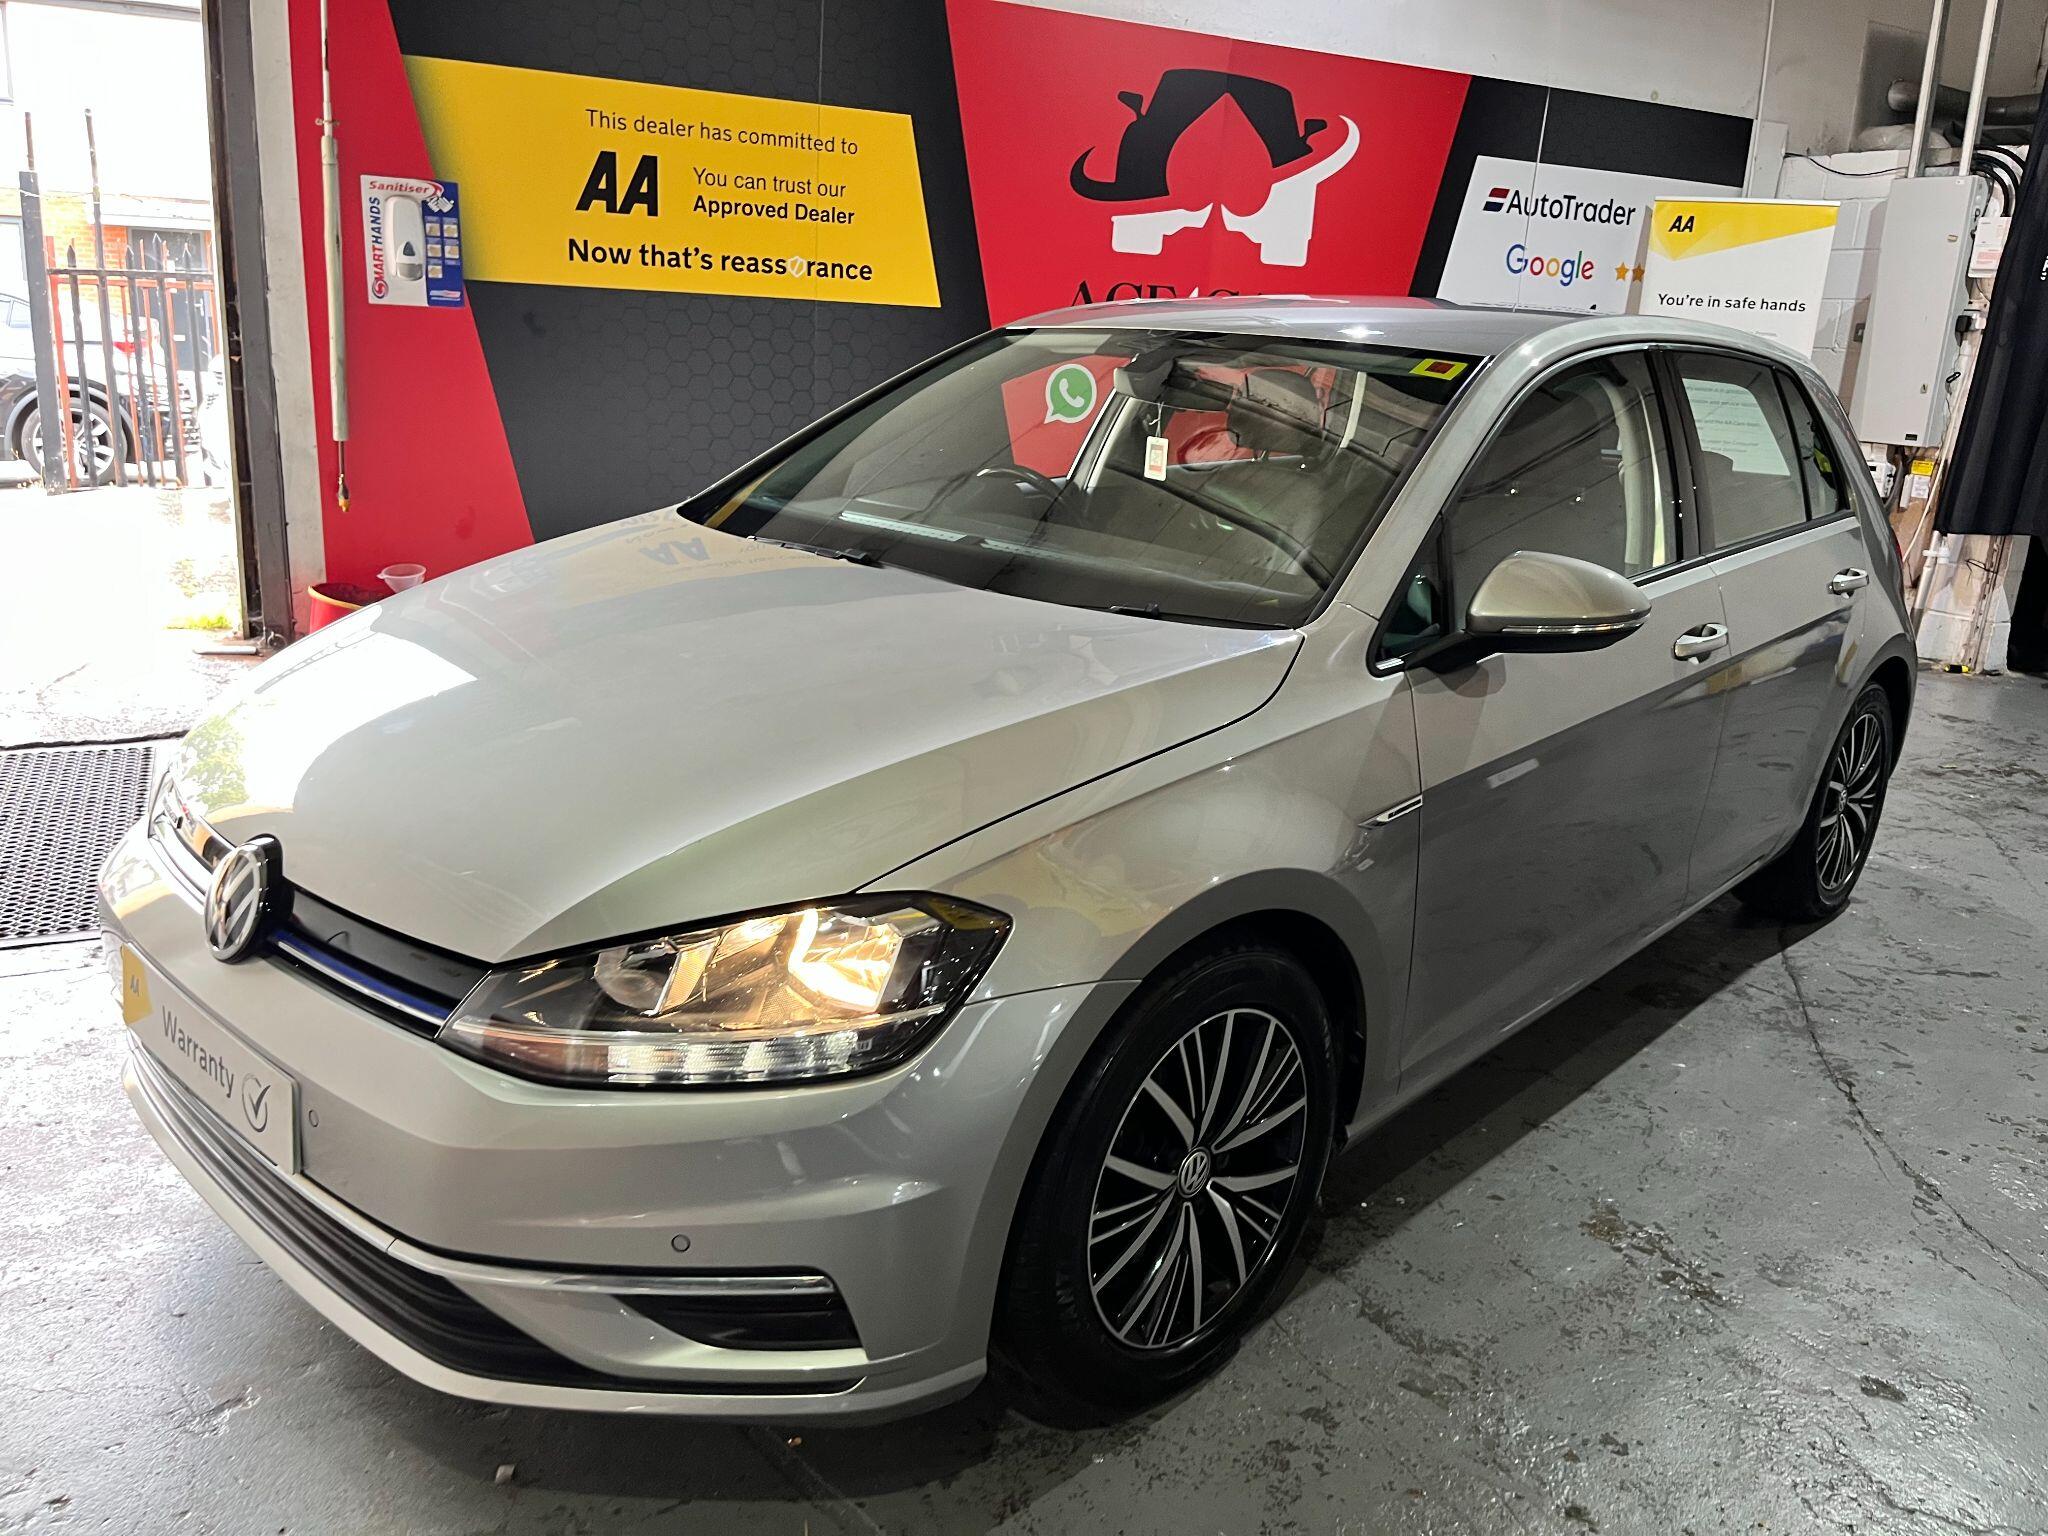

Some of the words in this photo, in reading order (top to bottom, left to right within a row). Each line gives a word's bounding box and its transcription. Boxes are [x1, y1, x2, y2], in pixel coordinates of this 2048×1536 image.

[585, 108, 627, 131] This
[633, 115, 695, 138] dealer
[700, 122, 733, 142] has
[738, 129, 835, 153] committed
[841, 138, 858, 155] to
[368, 180, 430, 195] Sanitiser
[575, 150, 659, 217] AA
[693, 167, 727, 187] You
[734, 174, 767, 192] can
[773, 176, 812, 195] trust
[817, 182, 847, 198] our
[693, 195, 788, 221] Approved
[795, 203, 856, 225] Dealer
[1505, 189, 1637, 226] AutoTrader
[1668, 215, 1695, 233] AA
[568, 238, 632, 265] Now
[639, 243, 713, 271] that’s
[1506, 243, 1595, 287] Google
[1658, 293, 1704, 307] You’re
[1707, 295, 1720, 308] in
[1724, 297, 1756, 310] safe
[1760, 298, 1807, 312] hands
[161, 1005, 235, 1098] Warranty
